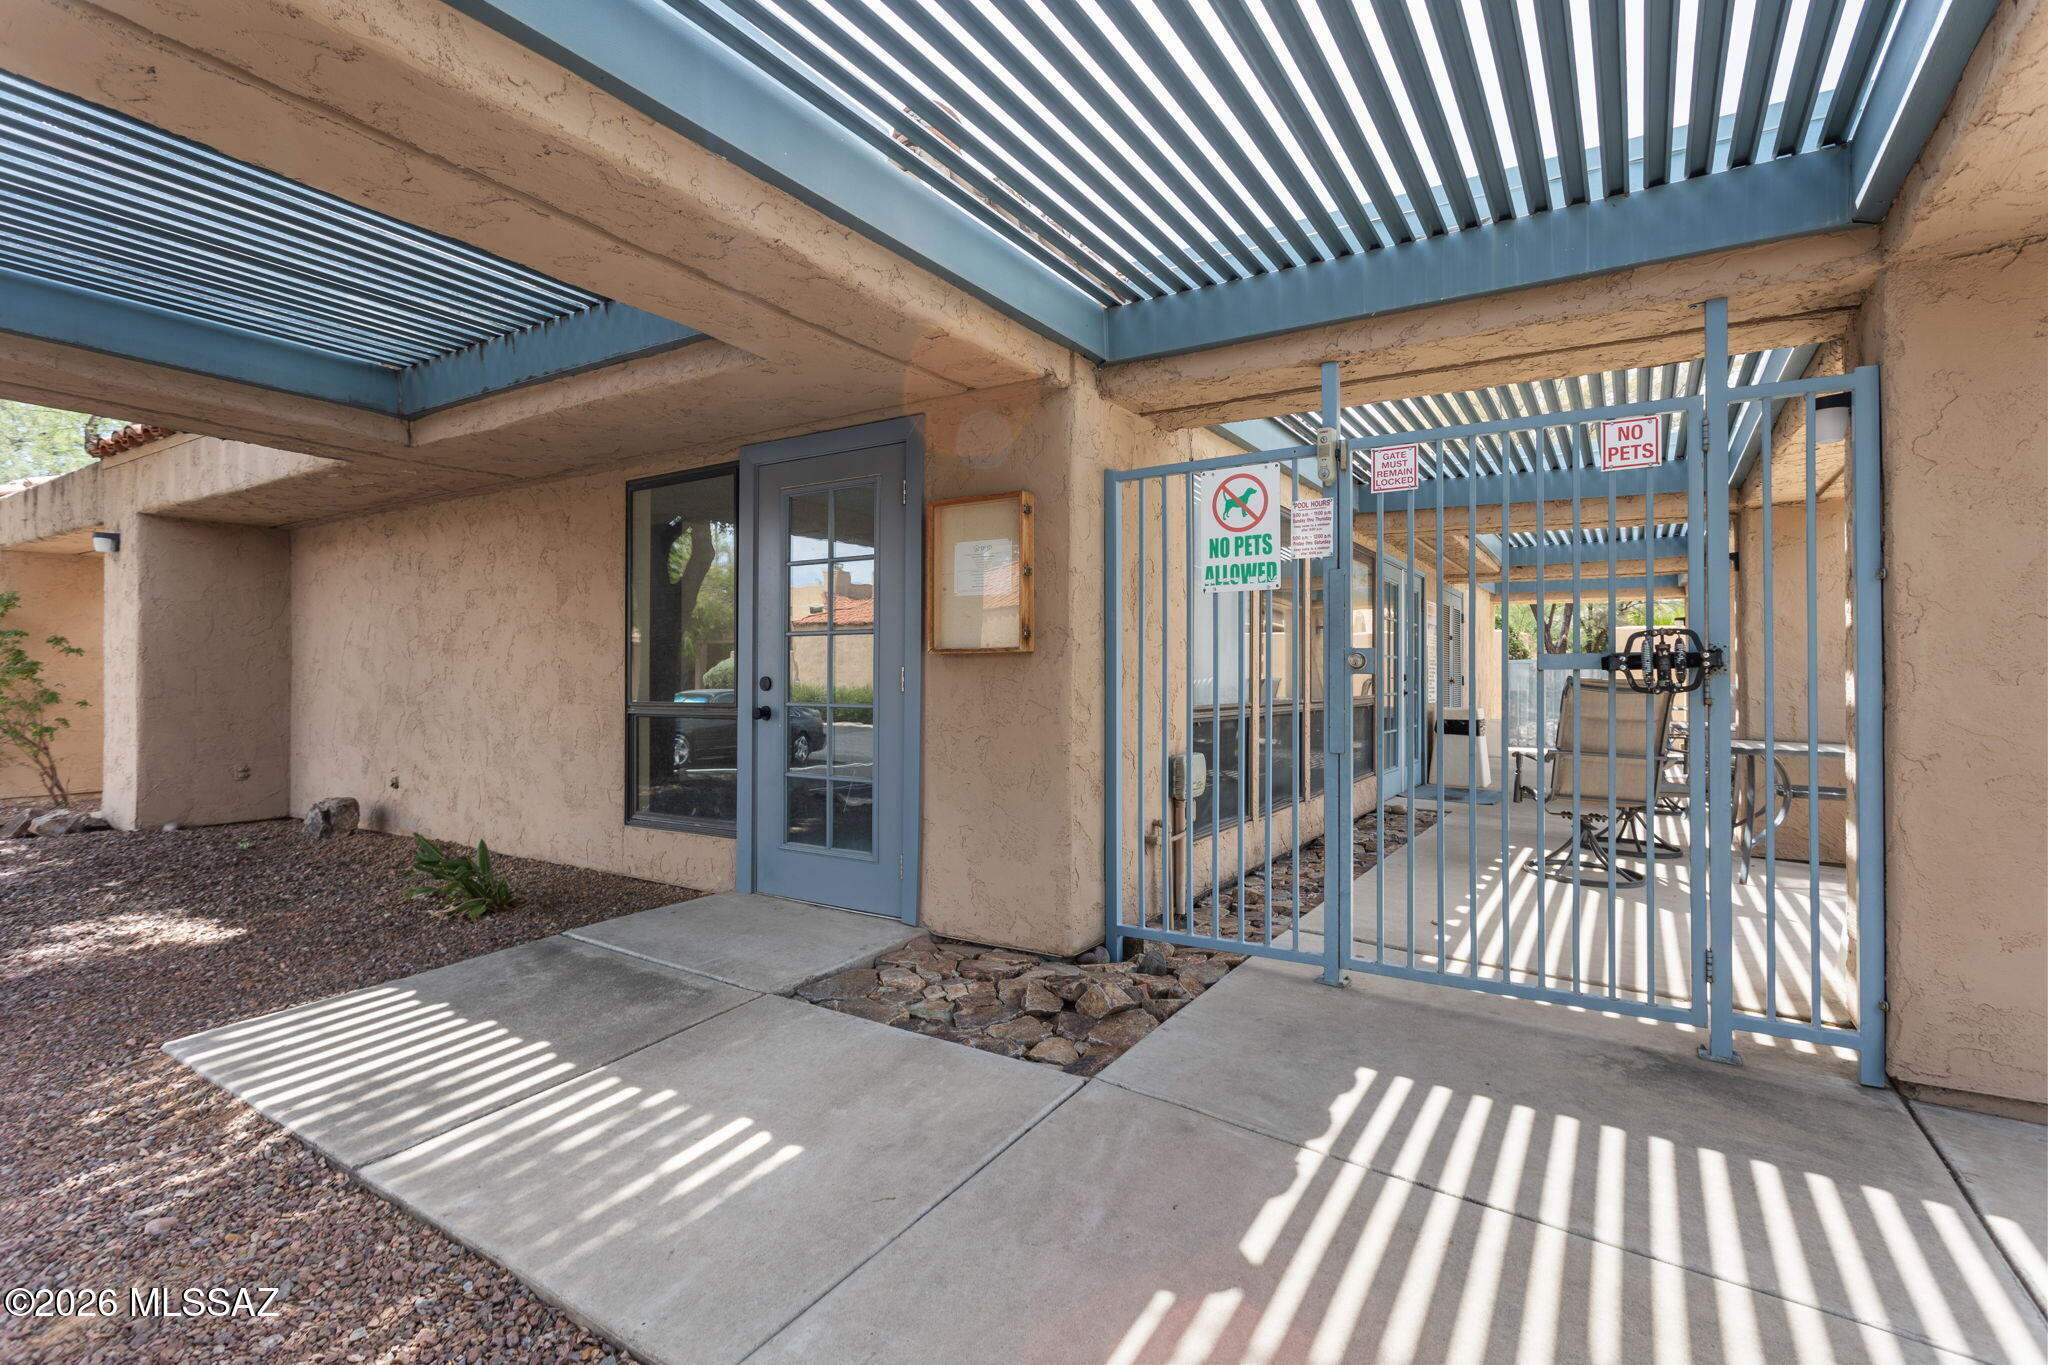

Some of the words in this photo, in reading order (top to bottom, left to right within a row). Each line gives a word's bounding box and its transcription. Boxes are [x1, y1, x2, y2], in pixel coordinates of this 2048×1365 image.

[1618, 424, 1643, 441] NO
[1382, 451, 1407, 460] GATE
[1608, 443, 1654, 462] PETS
[1382, 460, 1408, 469] MUST
[1376, 468, 1412, 478] REMAIN
[1375, 476, 1414, 487] LOCKED
[1209, 536, 1230, 558] NO
[1234, 533, 1273, 557] PETS
[1204, 561, 1278, 587] ALLOWED
